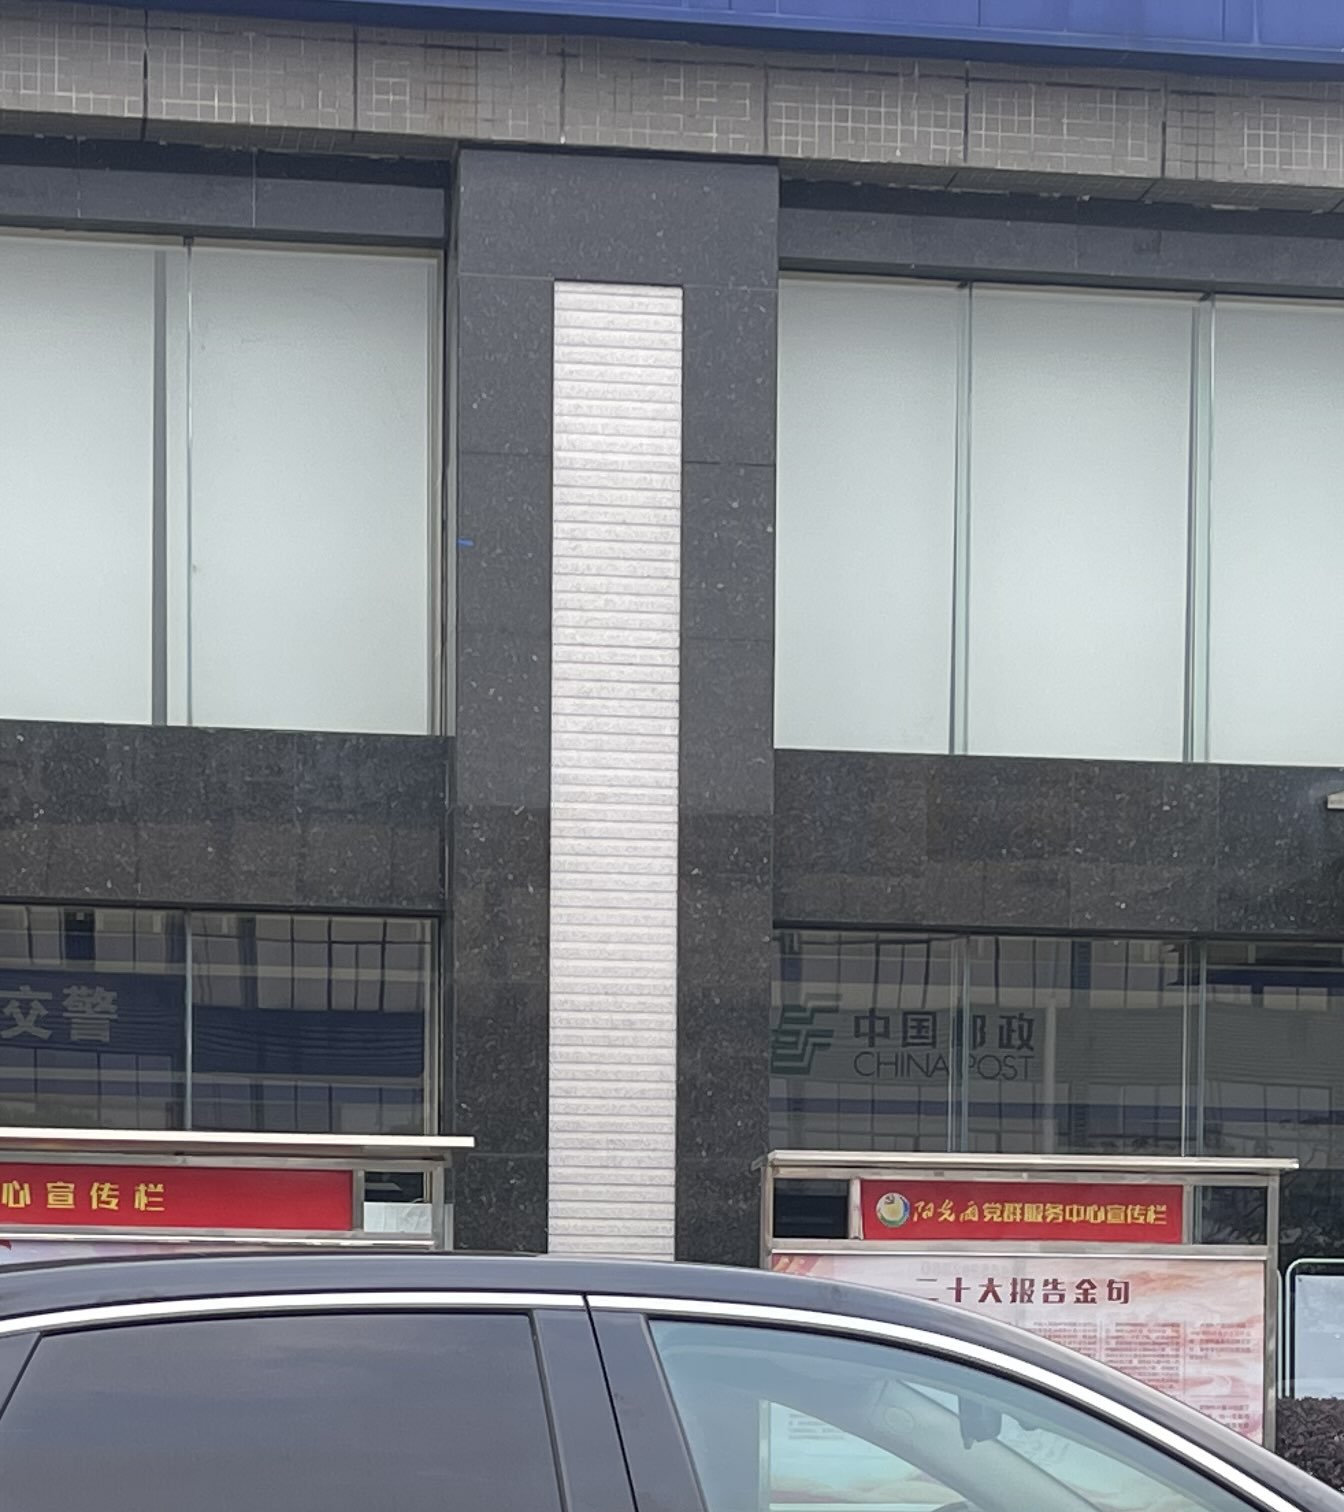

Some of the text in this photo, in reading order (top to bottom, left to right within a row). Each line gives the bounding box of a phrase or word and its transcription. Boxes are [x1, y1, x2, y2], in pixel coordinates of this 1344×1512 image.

[854, 1051, 950, 1078] CHINA
[915, 1276, 1130, 1305] 二十大报告金句
